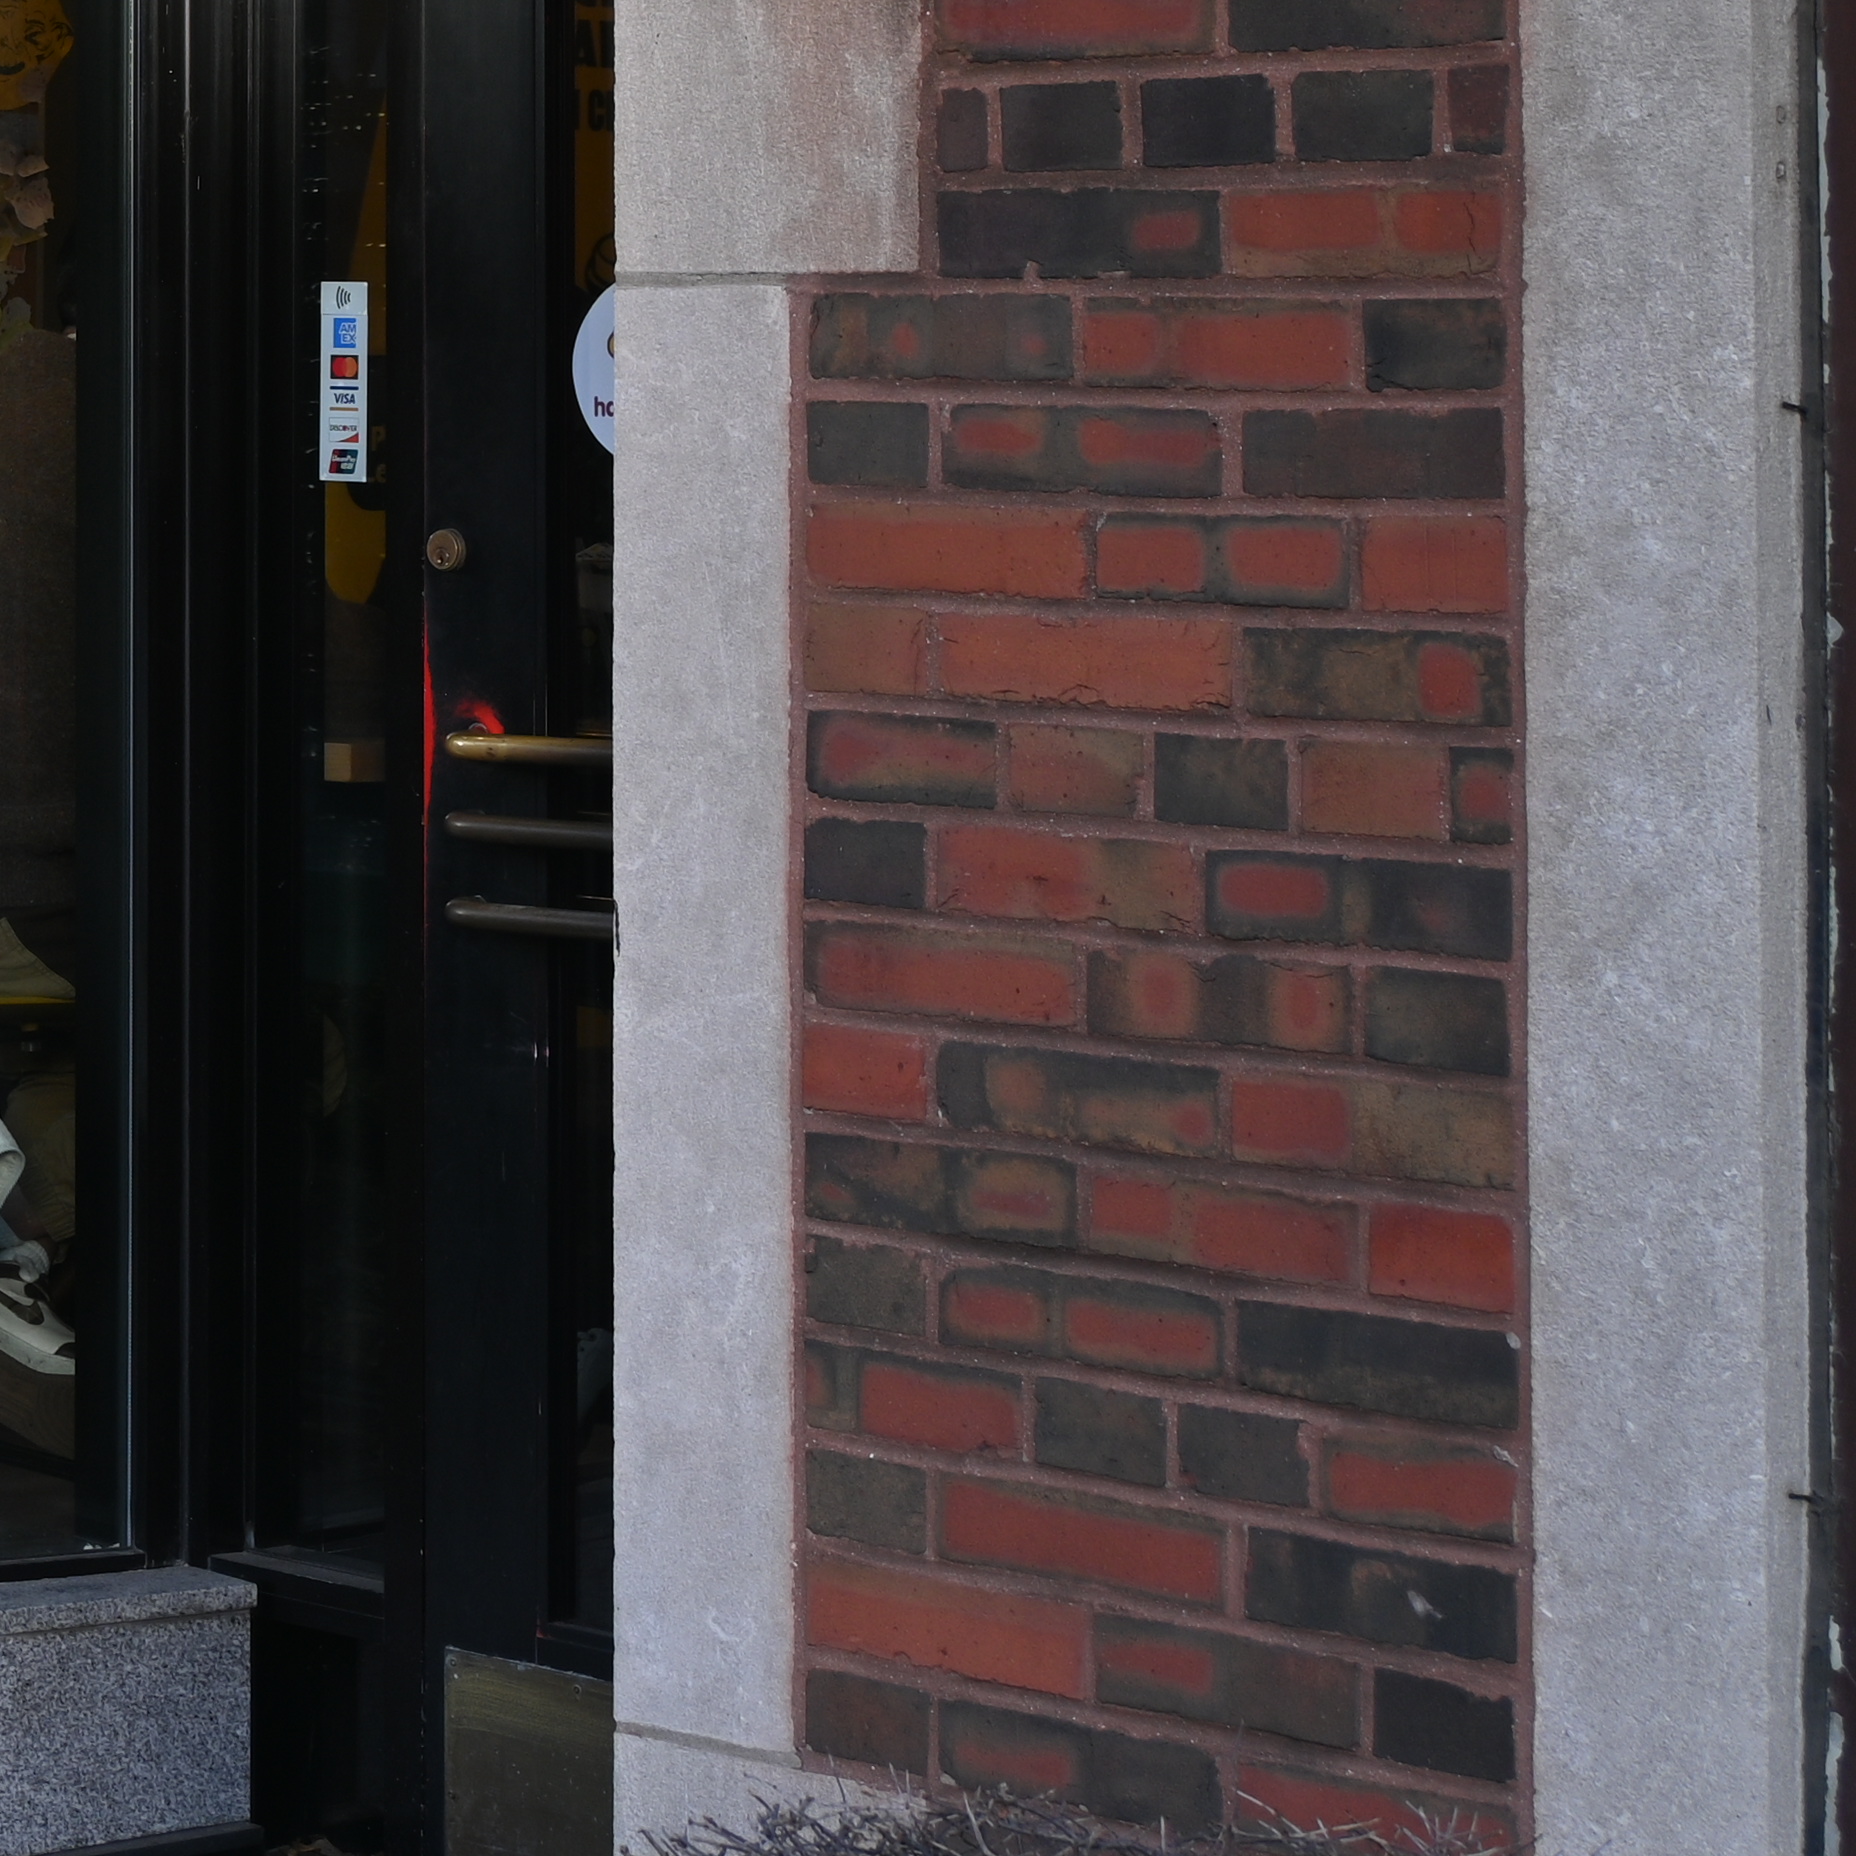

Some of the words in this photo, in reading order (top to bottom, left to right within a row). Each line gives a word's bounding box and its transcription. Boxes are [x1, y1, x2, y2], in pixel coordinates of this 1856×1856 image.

[338, 322, 356, 334] AM
[341, 333, 356, 344] EX
[334, 393, 356, 404] VISA
